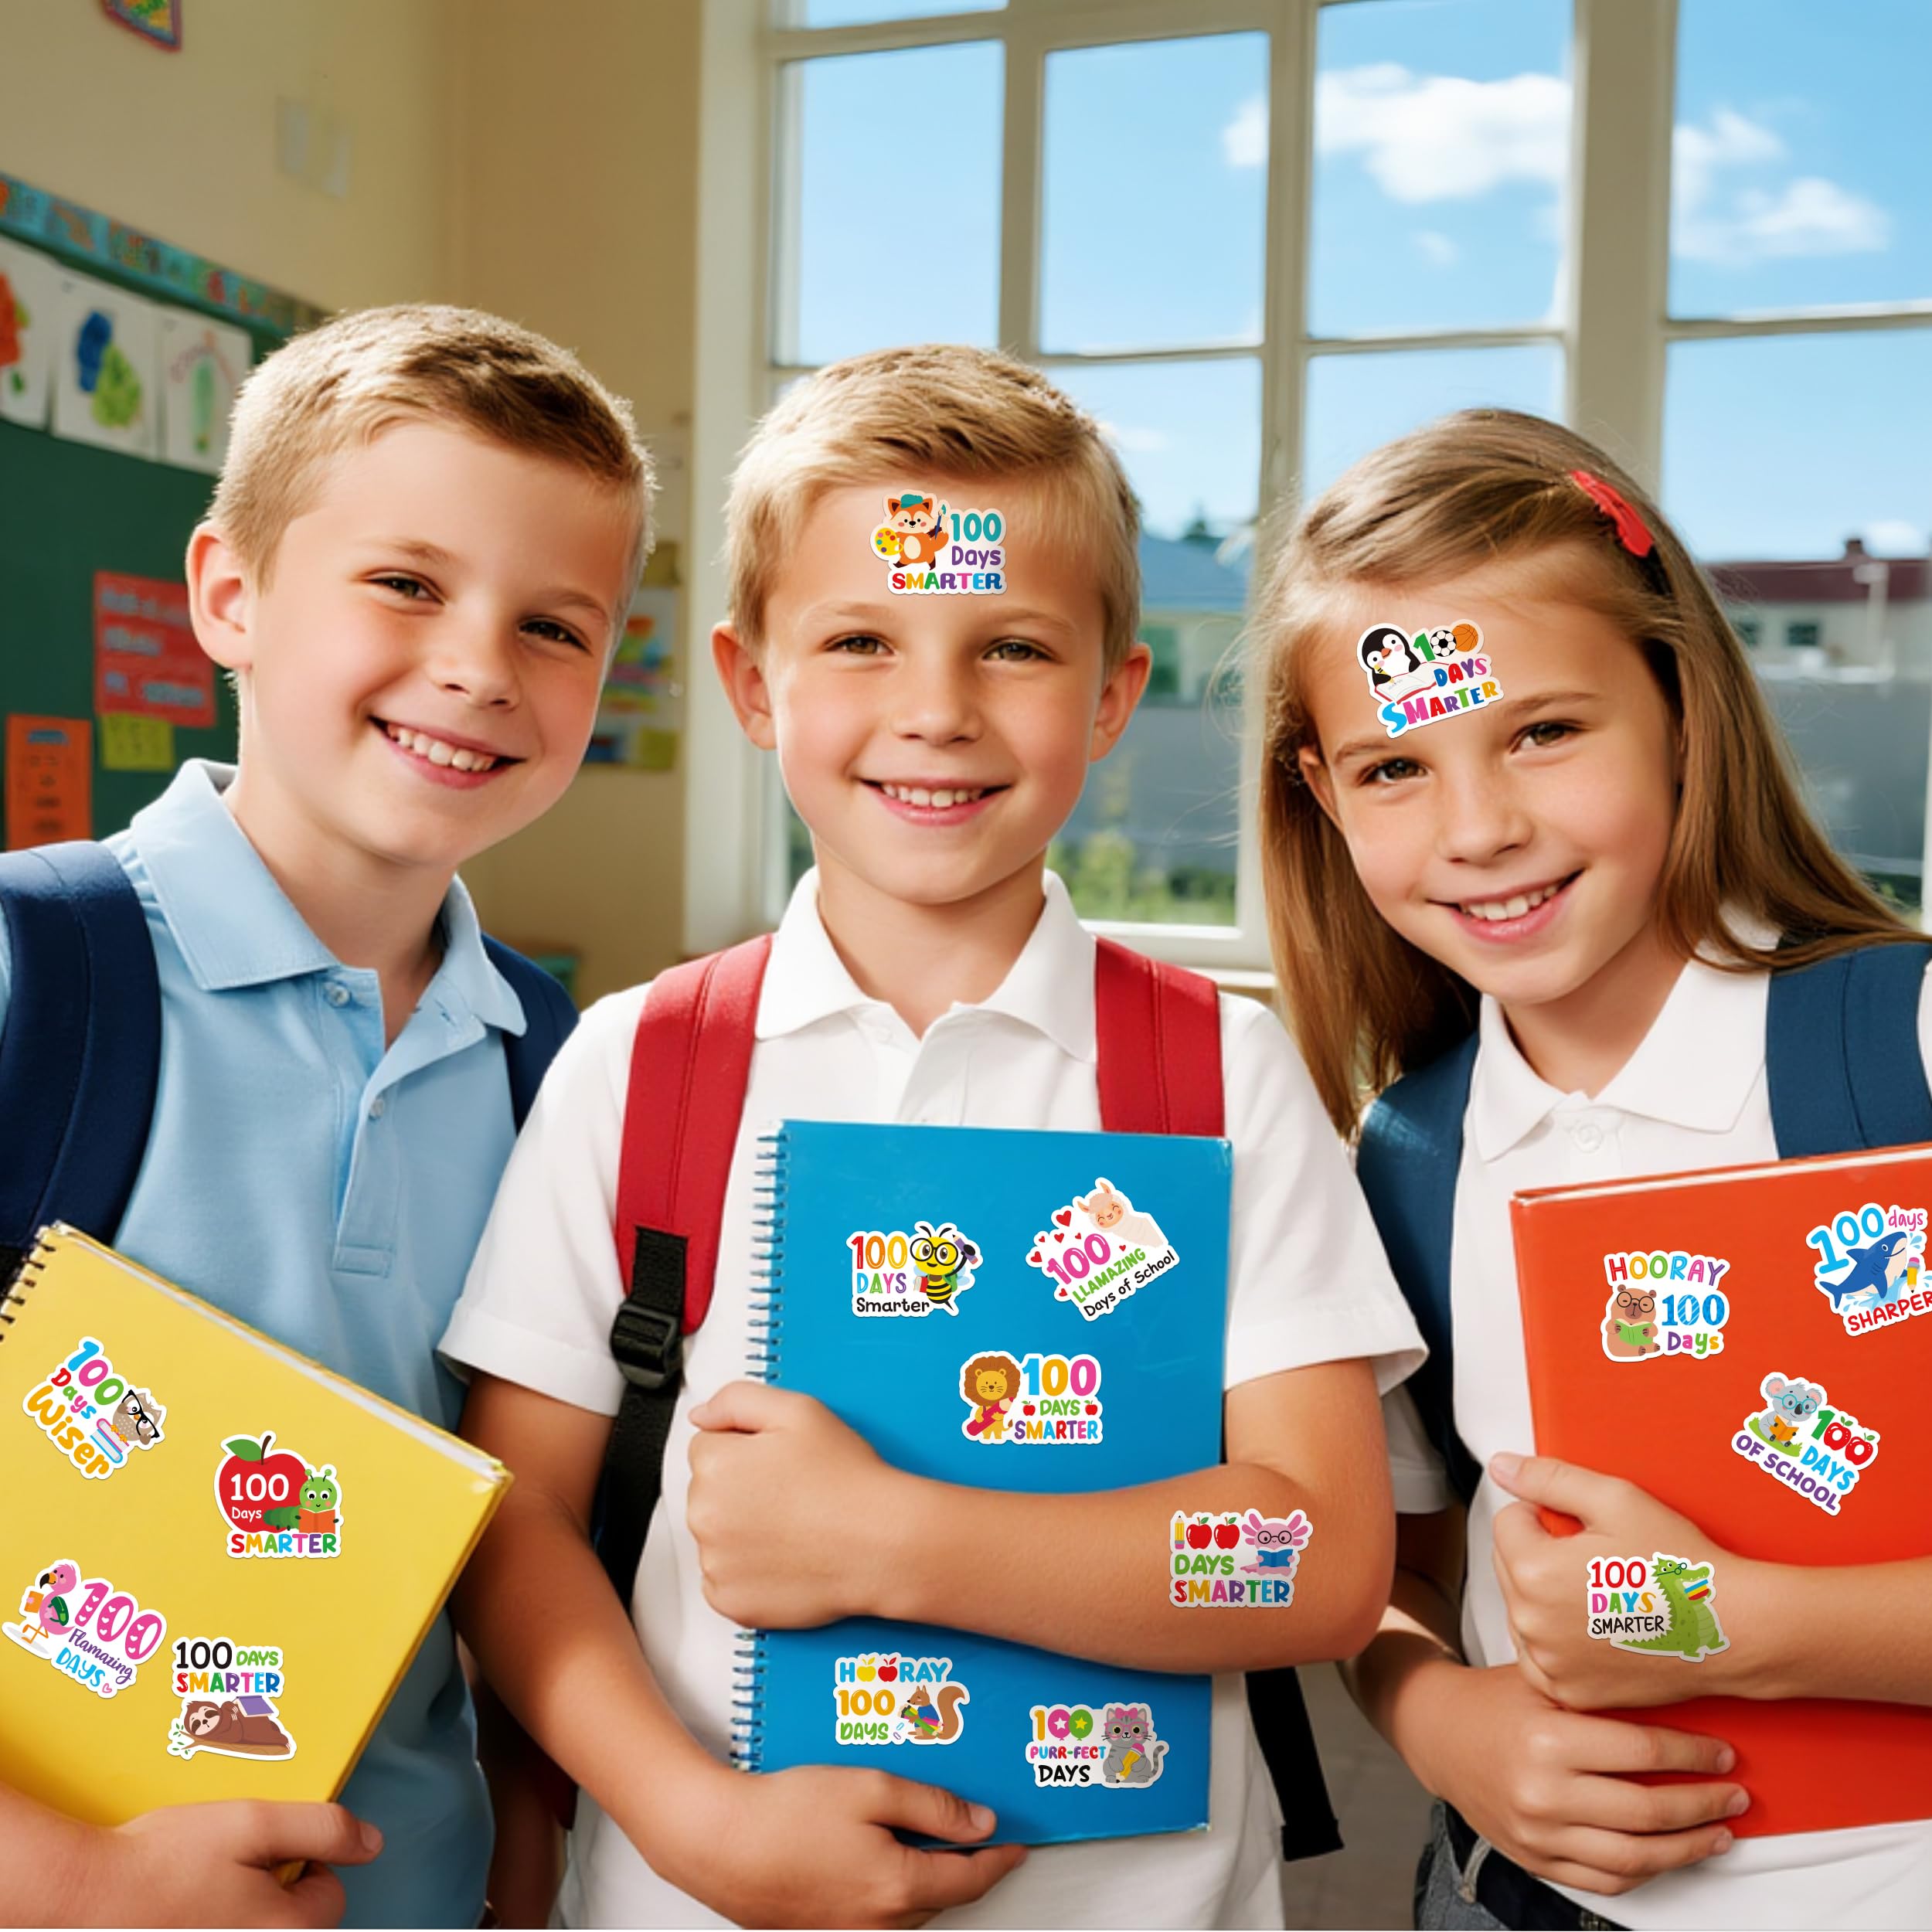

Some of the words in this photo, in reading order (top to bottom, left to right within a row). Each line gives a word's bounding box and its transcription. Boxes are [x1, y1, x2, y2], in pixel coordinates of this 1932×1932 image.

[951, 513, 1002, 542] 100
[951, 546, 1001, 569] Days
[892, 573, 1002, 590] SMARTER
[1434, 658, 1487, 687] DAYS
[1382, 681, 1498, 733] SMARTER
[851, 1236, 908, 1269] 100
[1811, 1208, 1884, 1274] 100
[1888, 1209, 1923, 1231] days
[1046, 1233, 1111, 1284] 100
[1609, 1255, 1725, 1286] HOORAY
[857, 1273, 906, 1294] DAYS
[1072, 1248, 1146, 1303] LLAMAZING
[1083, 1292, 1116, 1317] Days
[1118, 1278, 1131, 1294] of
[1134, 1250, 1175, 1284] School
[856, 1297, 930, 1312] Smarter
[1662, 1294, 1725, 1325] 100
[1668, 1332, 1719, 1354] Days
[68, 1341, 124, 1405] 100
[1022, 1358, 1097, 1396] 100
[51, 1368, 97, 1419] Days
[1040, 1400, 1080, 1416] DAYS
[27, 1385, 109, 1474] Wiser
[1015, 1420, 1098, 1440] SMARTER
[1811, 1410, 1875, 1465] 100
[1736, 1435, 1765, 1457] OF
[1764, 1453, 1837, 1511] SCHOOL
[1800, 1445, 1855, 1490] DAYS
[230, 1473, 289, 1501] 100
[232, 1507, 261, 1522] Days
[231, 1534, 336, 1553] SMARTER
[1175, 1554, 1234, 1575] DAYS
[1591, 1561, 1646, 1588] 100
[1174, 1580, 1290, 1603] SMARTER
[1592, 1591, 1656, 1614] DAYS
[74, 1582, 162, 1660] 100
[1591, 1615, 1665, 1634] SMARTER
[56, 1647, 105, 1687] DAYS
[69, 1628, 133, 1685] Flamazing
[176, 1641, 232, 1669] 100
[236, 1651, 278, 1666] DAYS
[176, 1672, 280, 1692] SMARTER
[838, 1689, 895, 1716] 100
[840, 1723, 889, 1740] DAYS
[1030, 1747, 1107, 1759] PURR-FECT
[1038, 1765, 1090, 1782] DAYS
